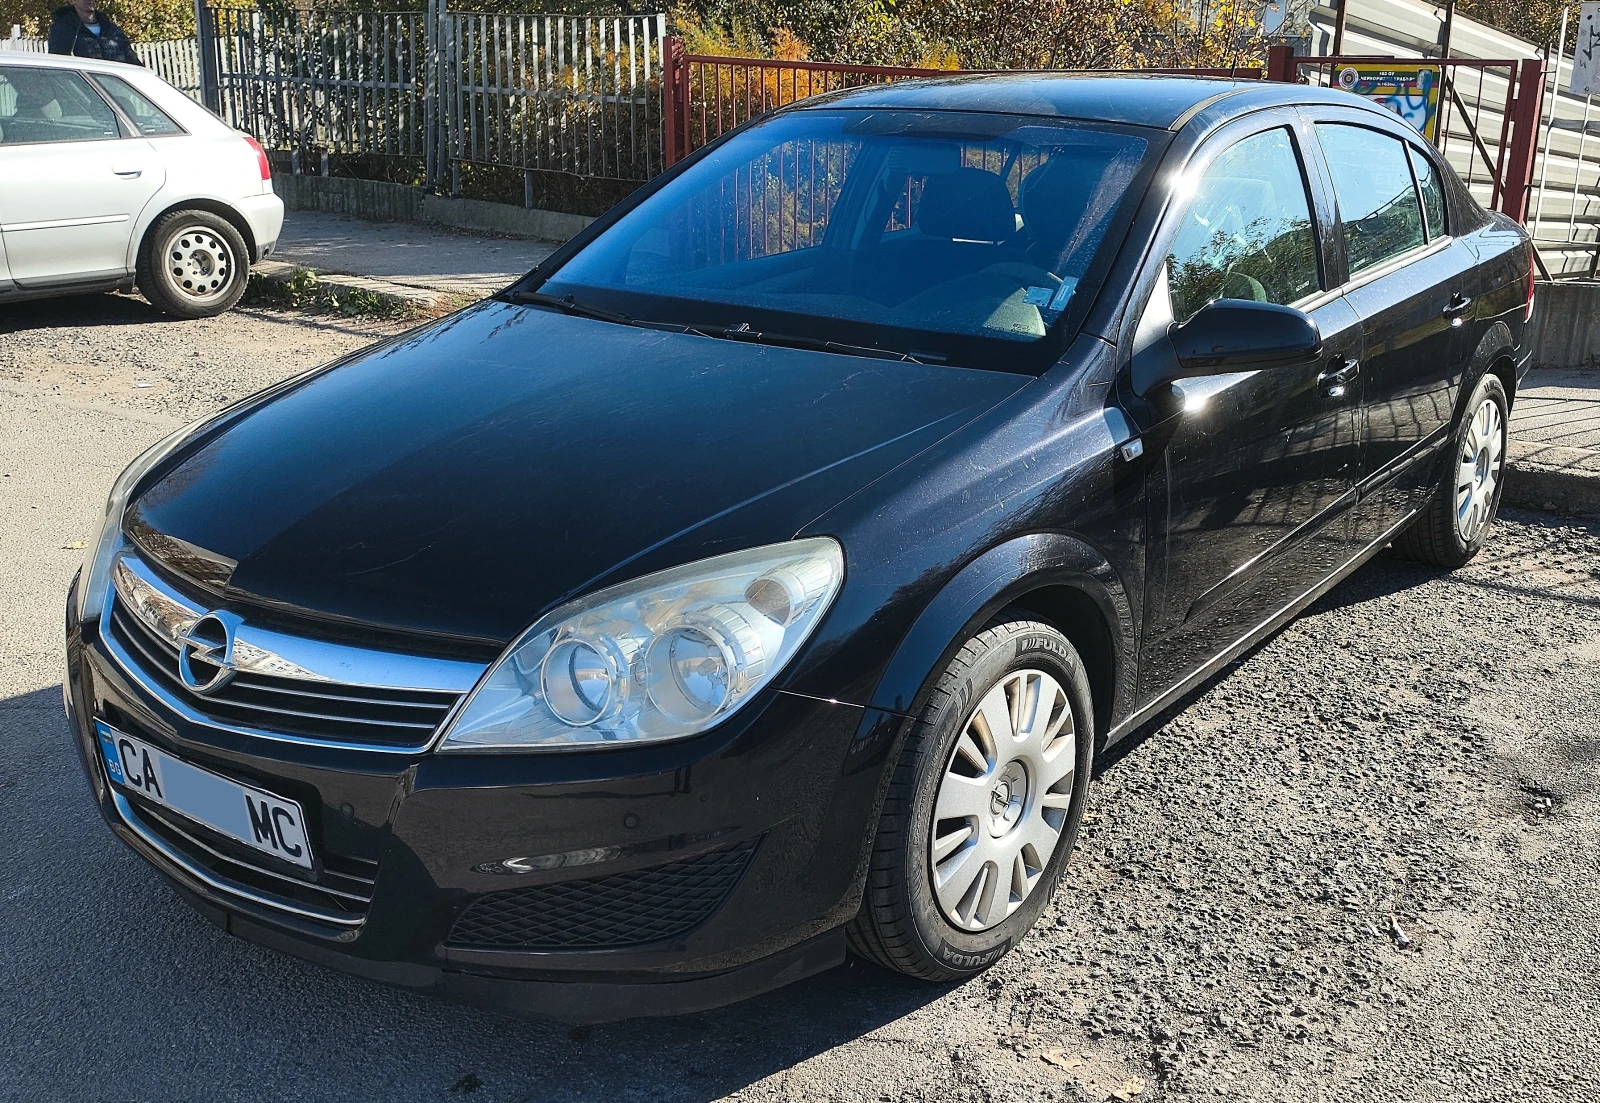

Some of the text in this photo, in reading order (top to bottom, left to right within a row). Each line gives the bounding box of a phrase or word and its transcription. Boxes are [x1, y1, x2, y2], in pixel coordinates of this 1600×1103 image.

[1032, 637, 1073, 667] FULDA
[109, 738, 302, 858] BG CA MC
[942, 946, 993, 966] FULDA
